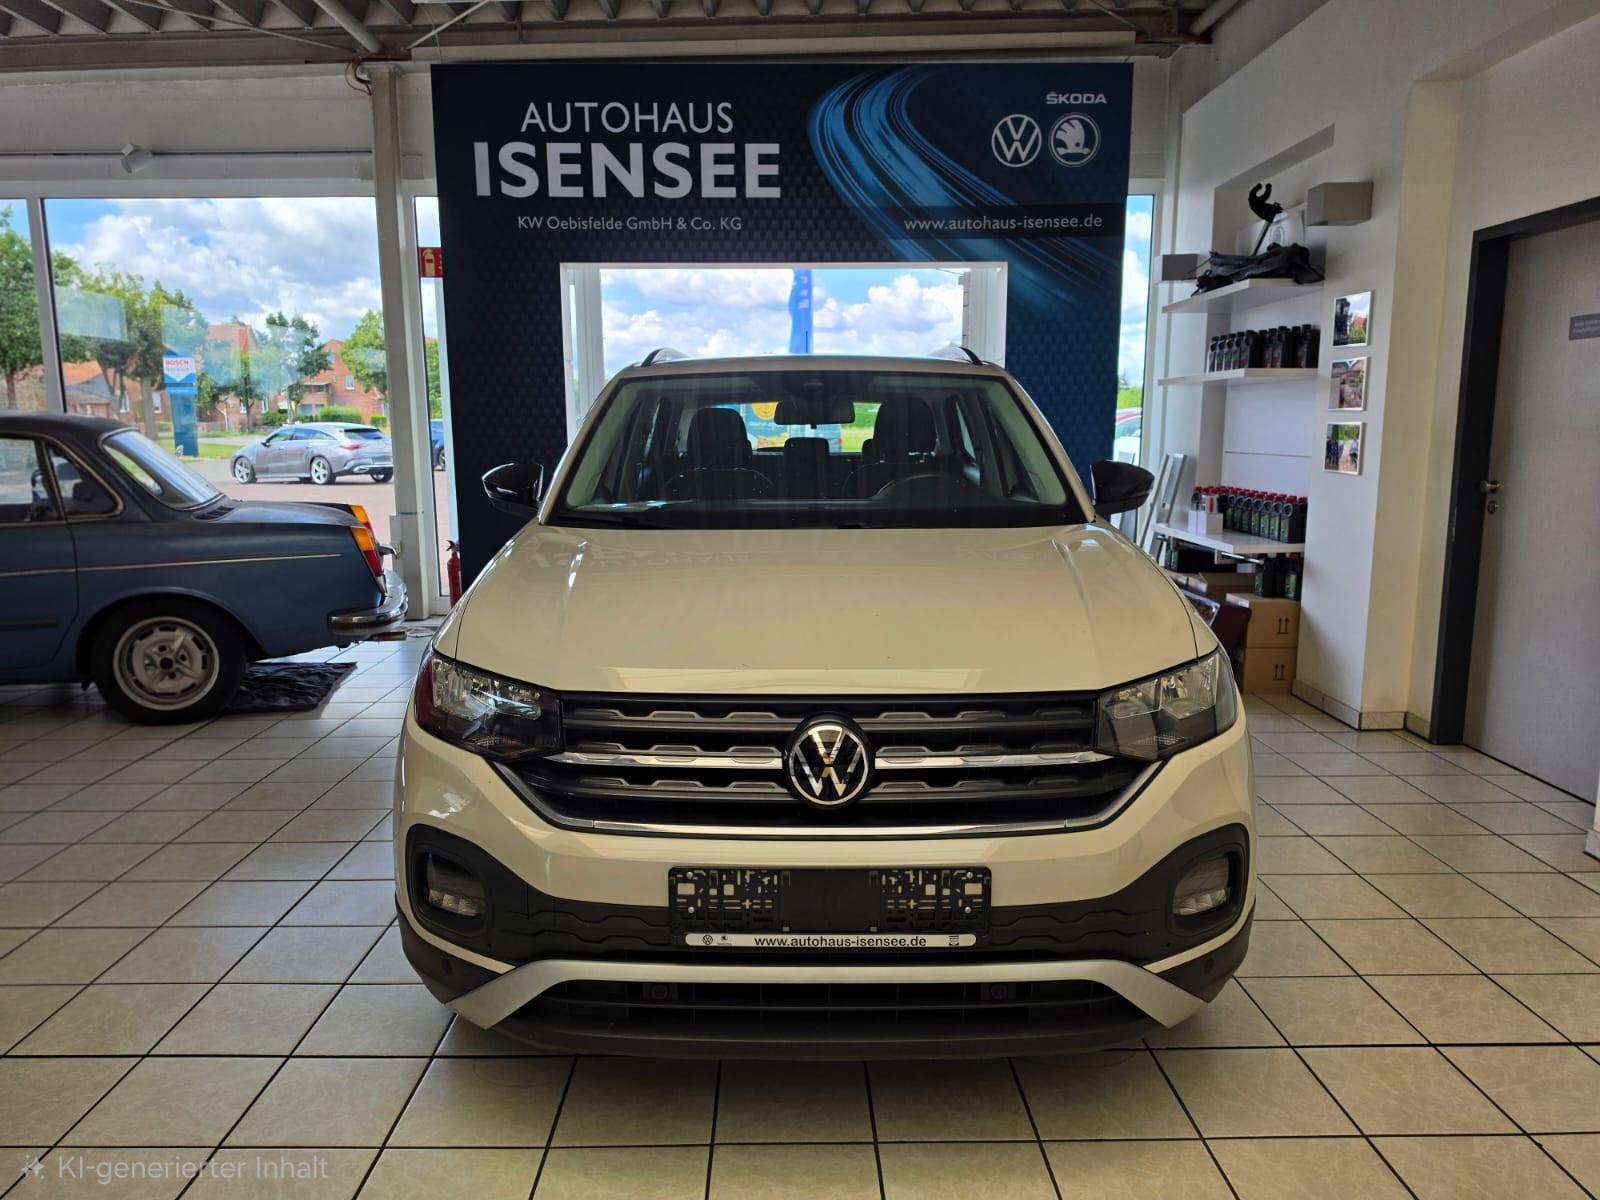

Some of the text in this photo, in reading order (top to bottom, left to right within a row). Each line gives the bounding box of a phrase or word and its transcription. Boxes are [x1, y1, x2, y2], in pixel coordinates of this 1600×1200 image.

[1046, 91, 1107, 104] ŠKODA
[520, 101, 734, 133] AUTOHAUS
[473, 141, 782, 199] ISENSEE
[517, 215, 742, 231] KW Oebisfelde GmbH & Co. KG
[903, 213, 1103, 231] www.autohaus-isensee.de
[754, 934, 927, 947] www.autohaus-isensee.de
